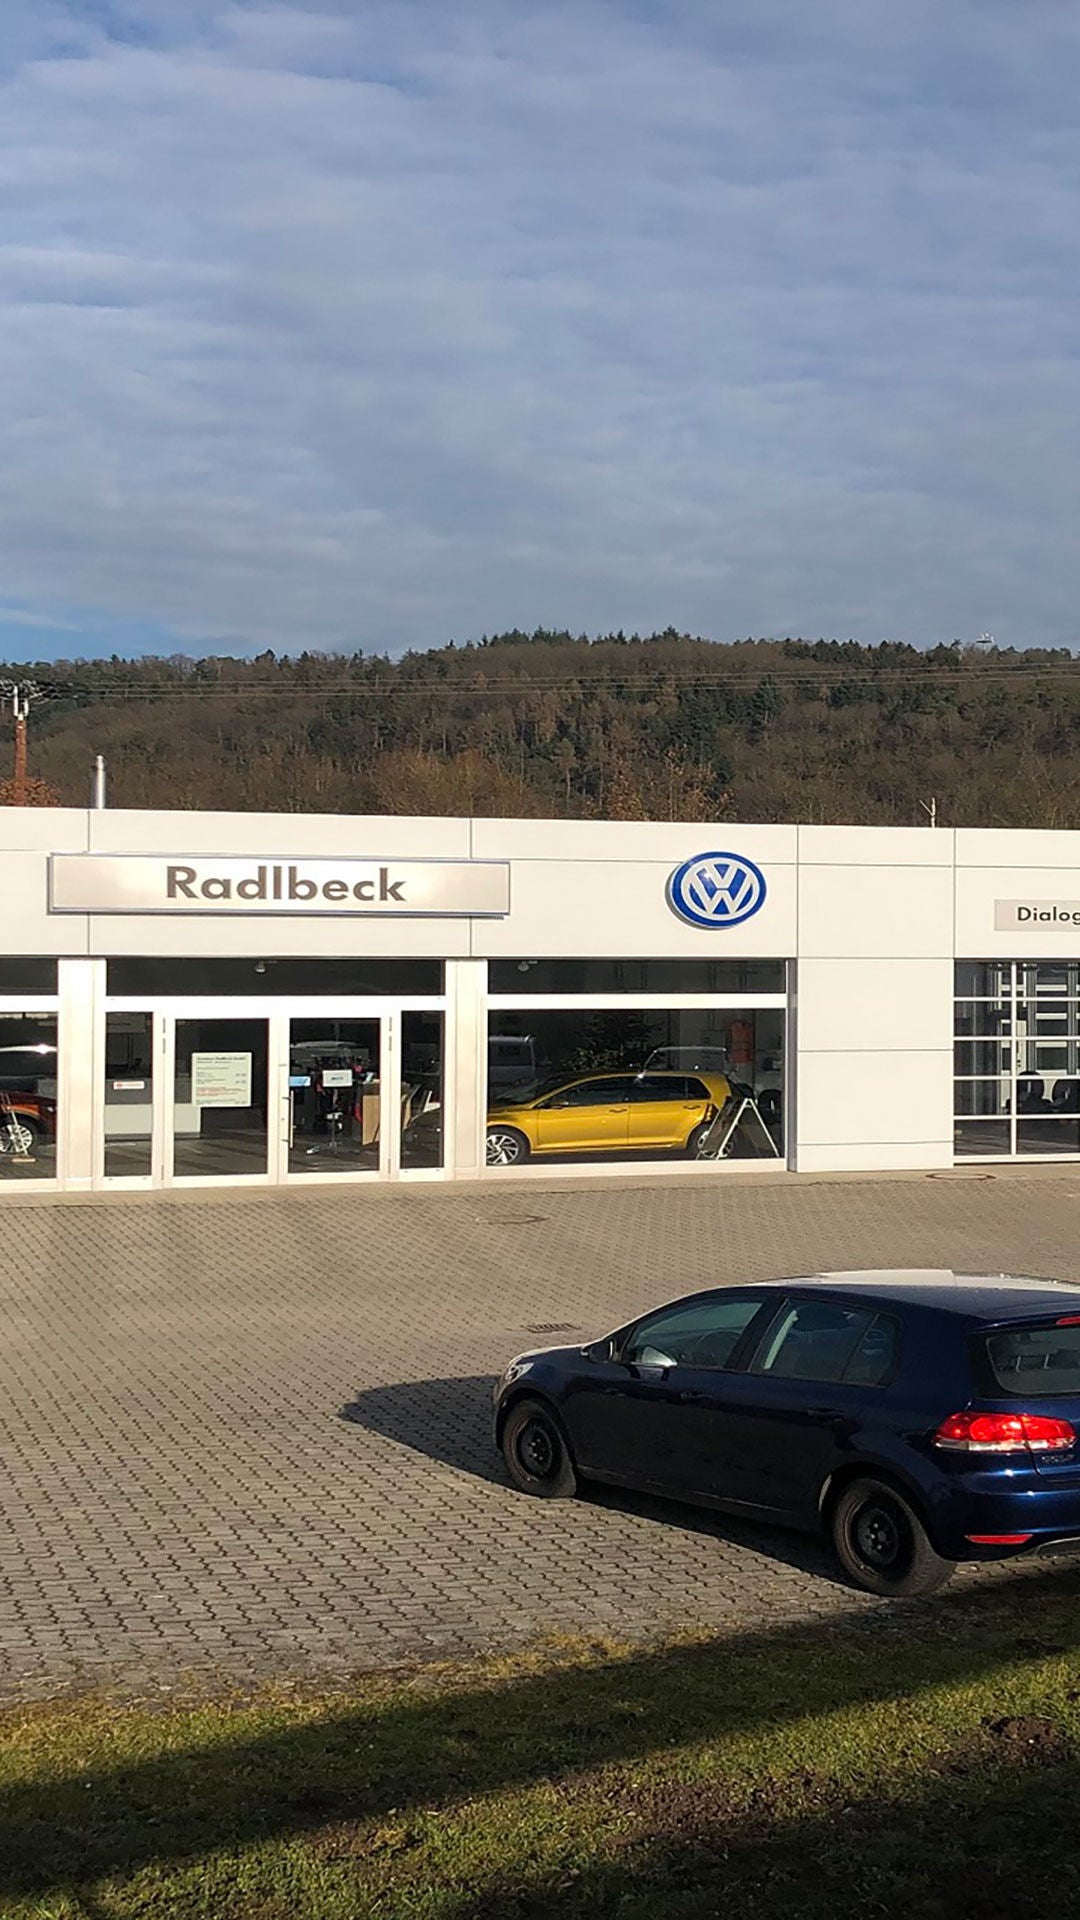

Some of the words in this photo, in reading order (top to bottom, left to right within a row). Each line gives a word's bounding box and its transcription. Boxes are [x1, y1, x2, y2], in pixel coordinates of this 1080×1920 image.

[166, 865, 407, 902] Radlbeck
[681, 858, 760, 919] VW
[1017, 906, 1080, 925] Dialog
